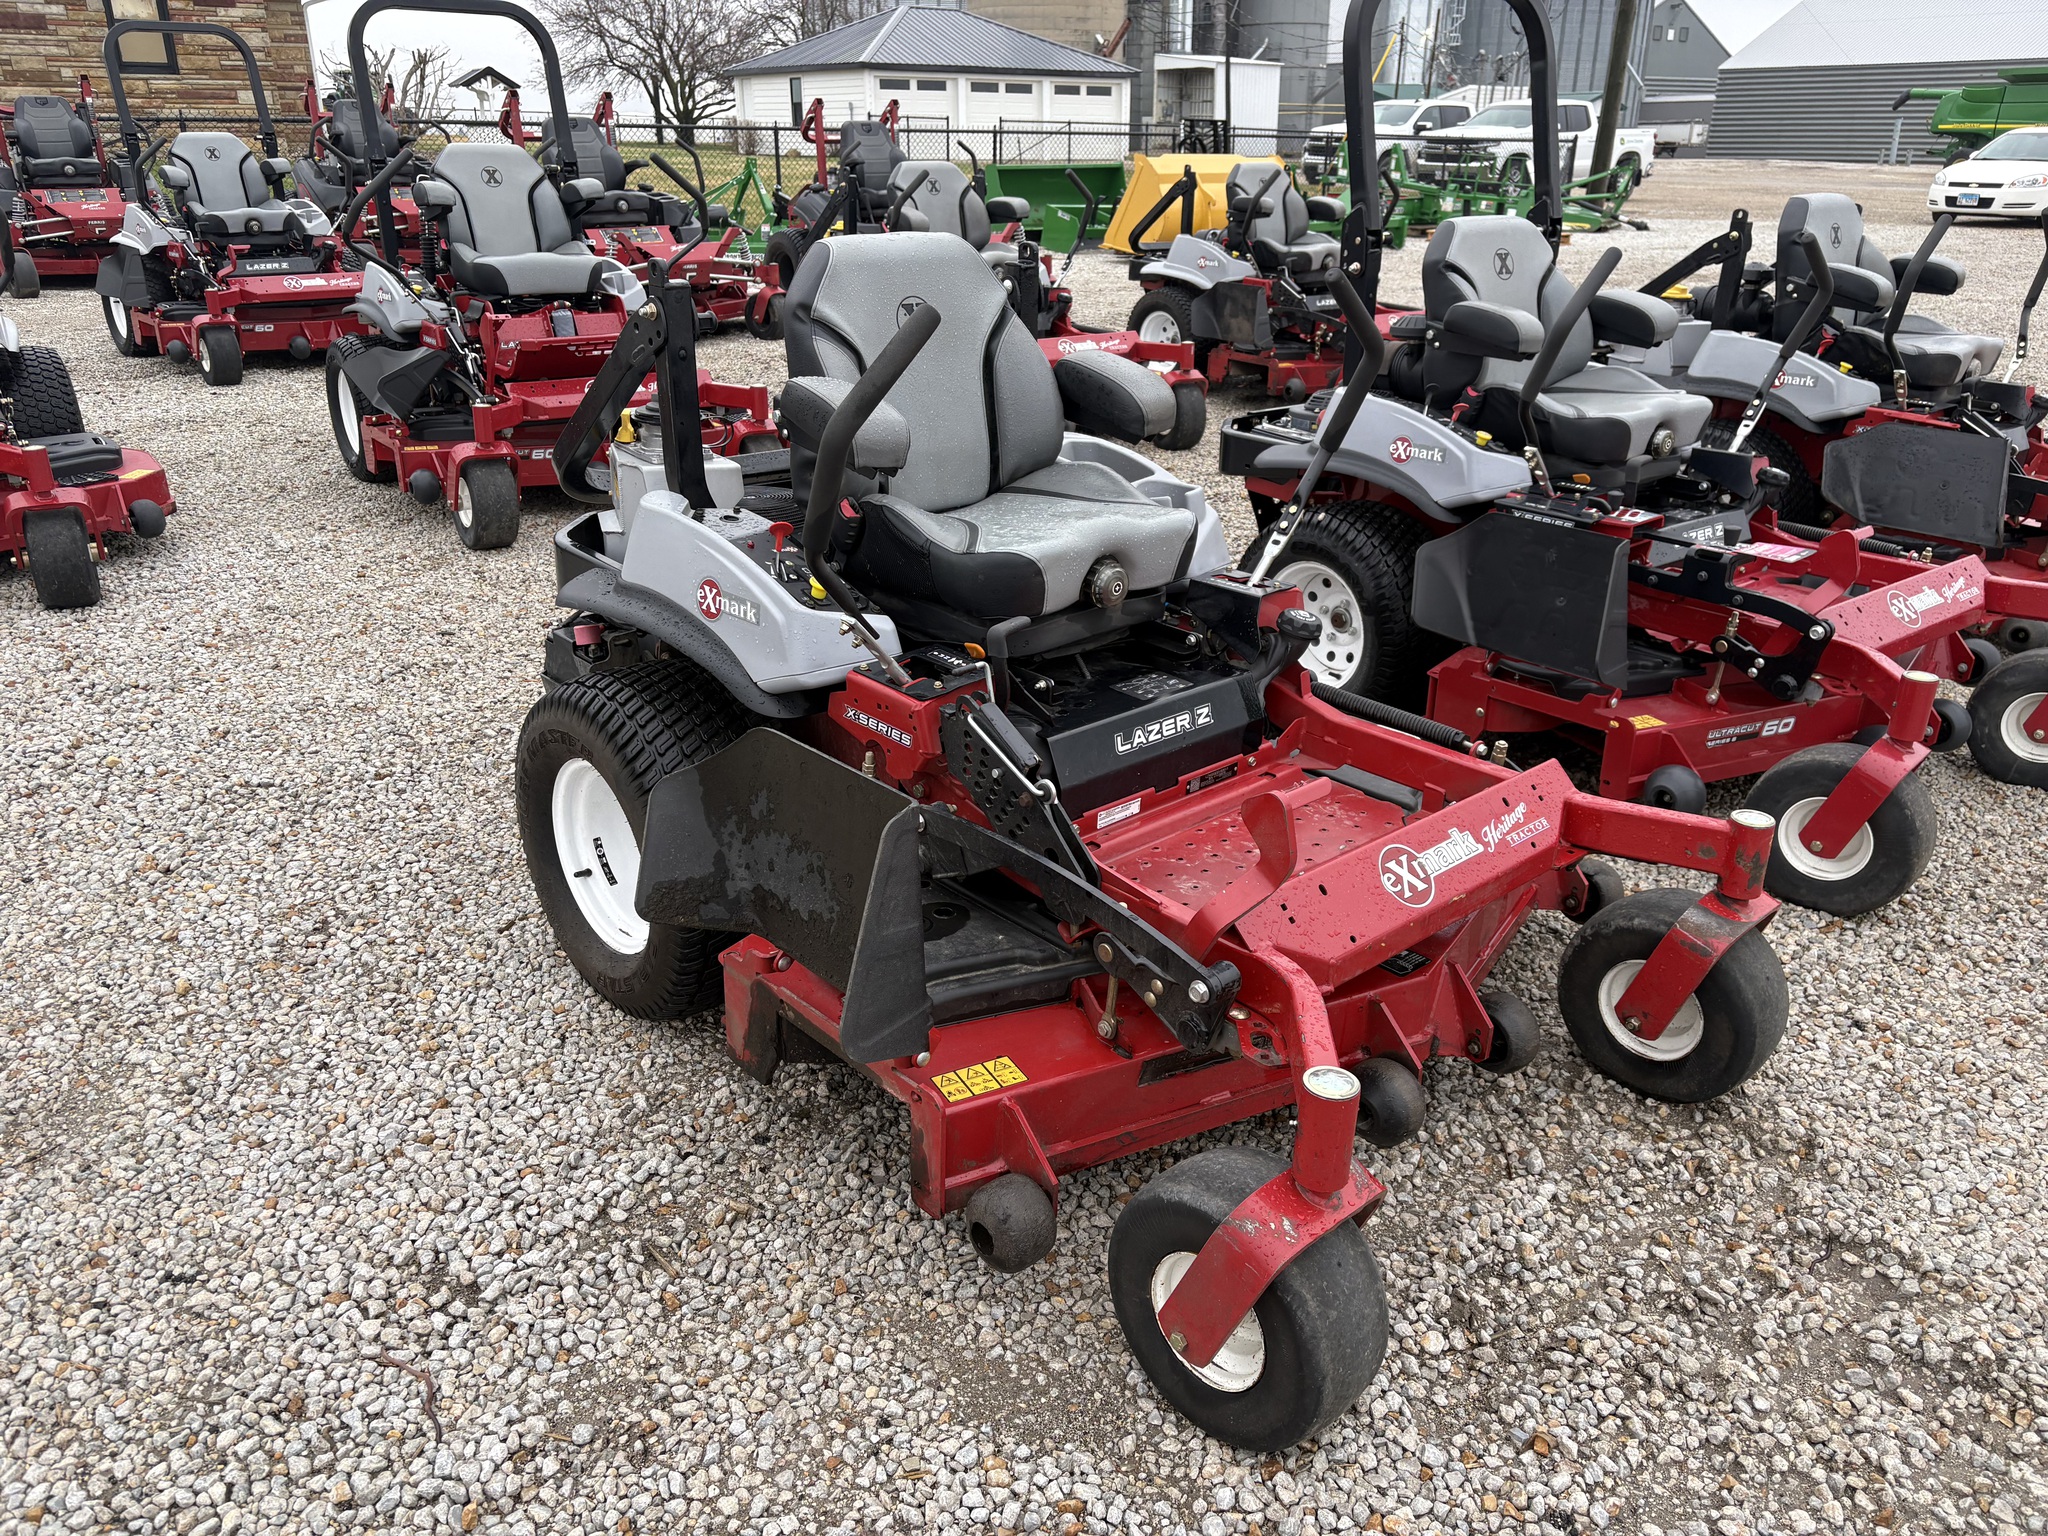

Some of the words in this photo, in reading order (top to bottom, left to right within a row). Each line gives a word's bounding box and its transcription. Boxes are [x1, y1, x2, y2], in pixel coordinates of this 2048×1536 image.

[206, 148, 220, 158] X
[483, 169, 502, 184] X
[927, 180, 941, 193] X
[1831, 226, 1841, 244] X
[1496, 252, 1512, 275] X
[1316, 299, 1337, 307] LAZE
[254, 324, 274, 332] 60
[1389, 440, 1443, 462] eXmark
[1941, 576, 1966, 604] Heritage
[697, 583, 756, 623] eXmark
[1890, 584, 1945, 623] eXmark
[844, 704, 912, 747] X-SERIES
[1115, 711, 1194, 754] LAZER
[1195, 704, 1213, 728] Z
[1708, 722, 1763, 739] ULTRACUT
[1761, 716, 1796, 737] 60
[1481, 801, 1527, 853] Heritage
[1506, 817, 1550, 847] TRACTOR
[1382, 827, 1483, 901] eXmark
